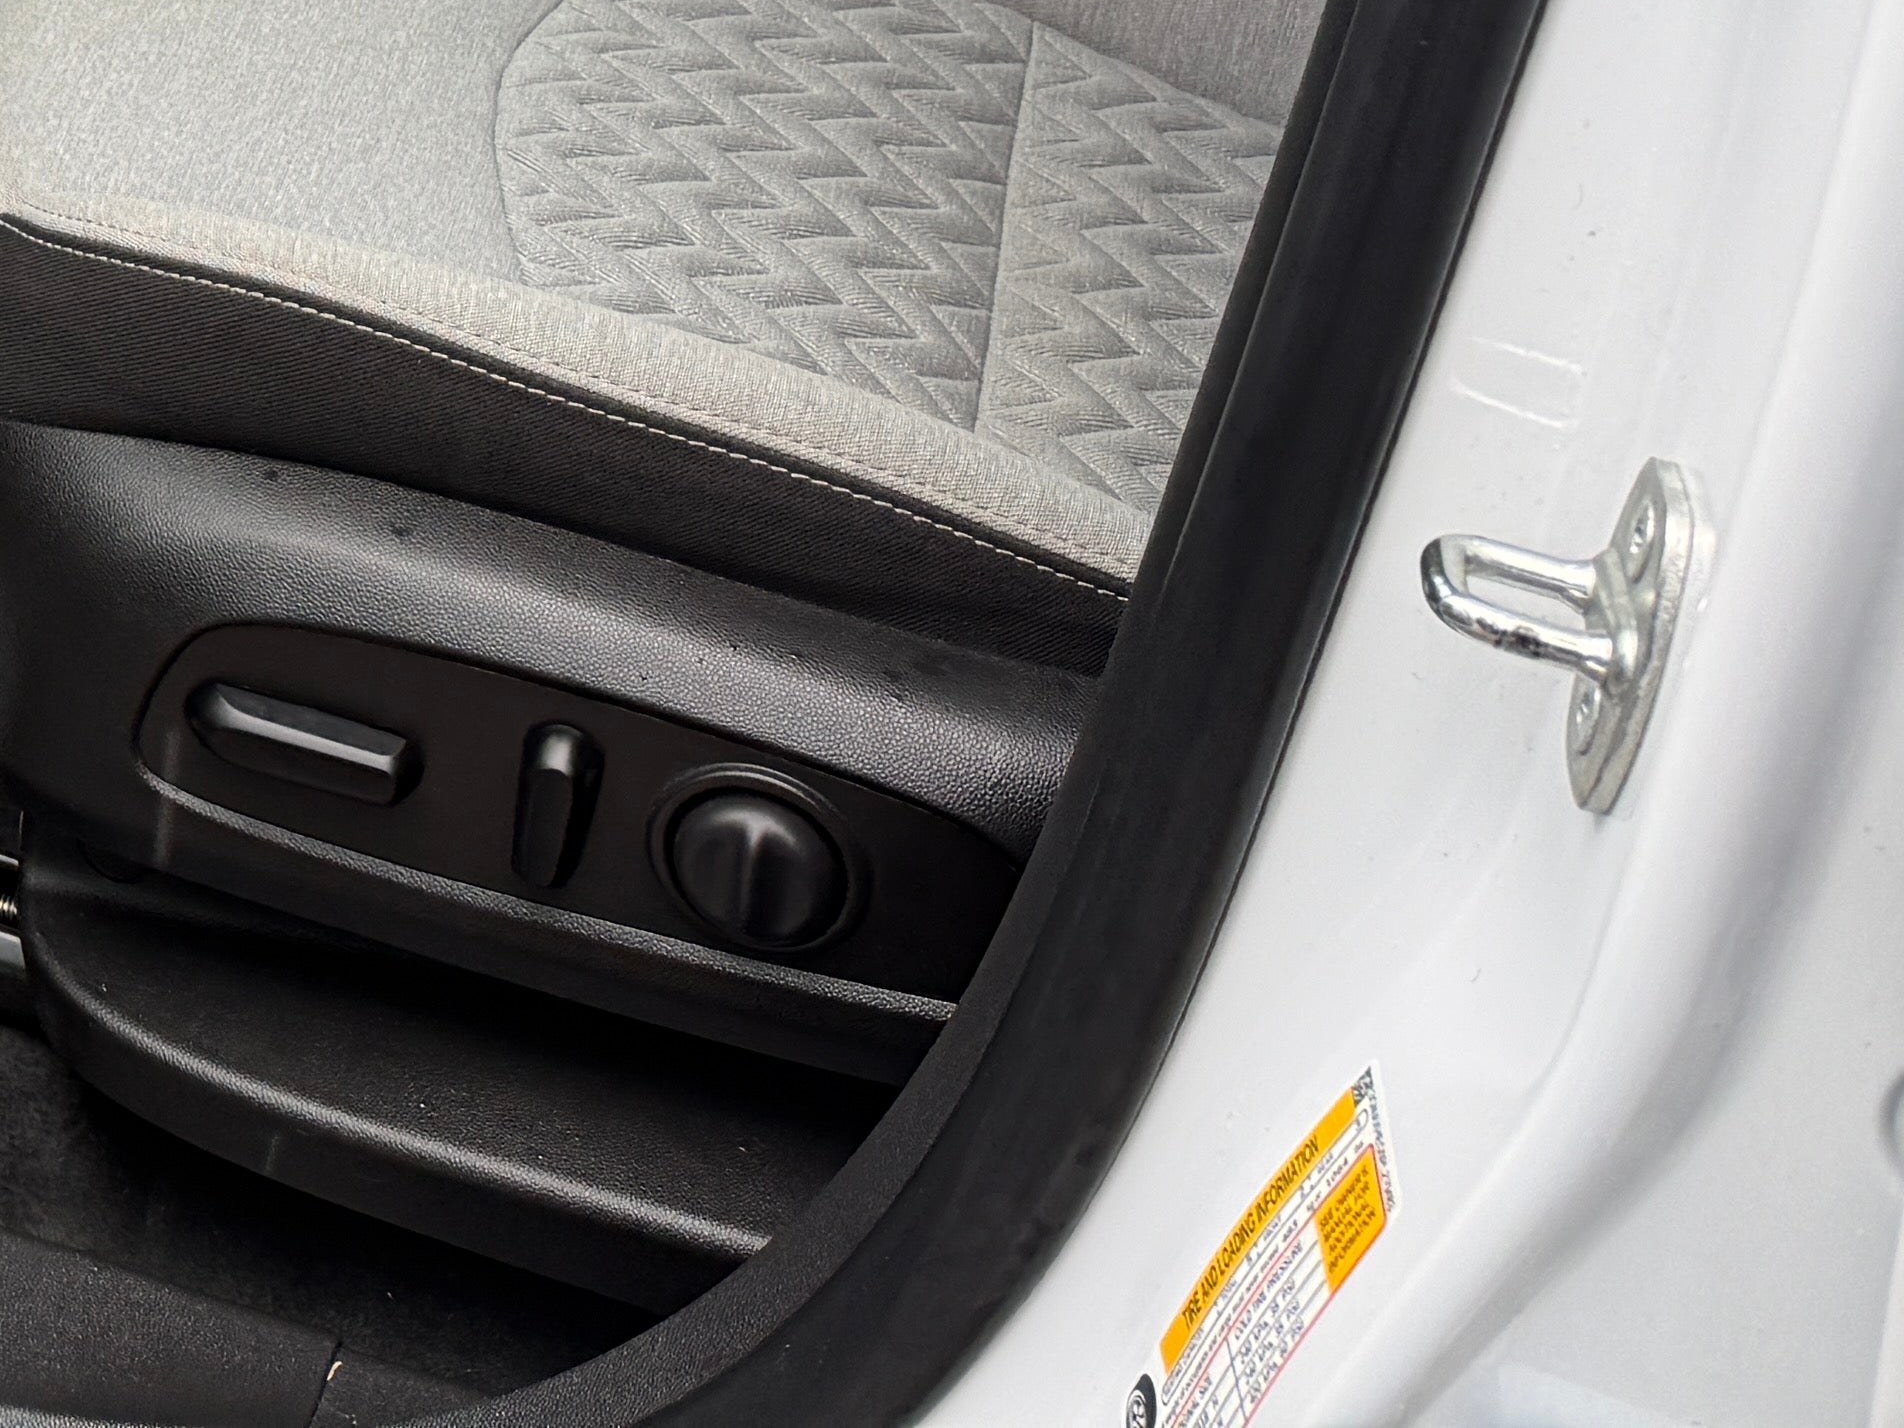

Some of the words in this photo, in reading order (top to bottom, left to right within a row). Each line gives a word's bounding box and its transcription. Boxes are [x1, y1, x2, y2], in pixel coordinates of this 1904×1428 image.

[1181, 1291, 1202, 1331] TIRE
[1200, 1265, 1219, 1304] AND
[1216, 1212, 1256, 1277] LOADING
[1255, 1134, 1320, 1225] INFORMATION
